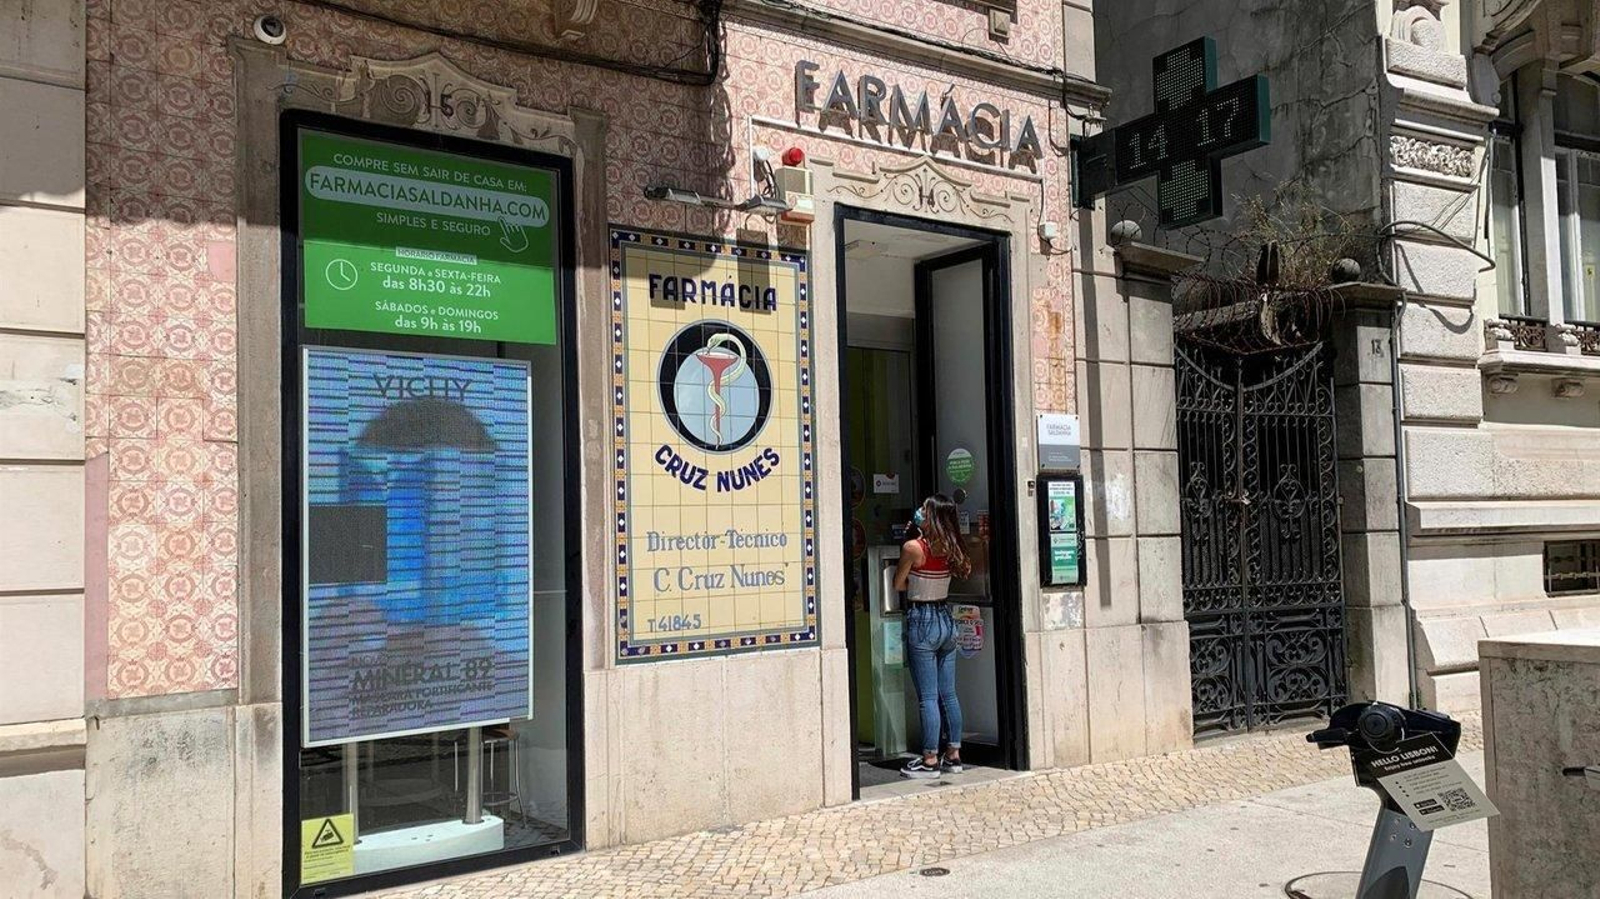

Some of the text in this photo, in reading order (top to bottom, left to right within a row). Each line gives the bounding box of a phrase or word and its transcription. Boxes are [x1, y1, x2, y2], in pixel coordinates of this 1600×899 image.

[795, 59, 1043, 159] FARMÁCIA
[1129, 97, 1239, 169] 14 17
[333, 153, 527, 192] COMPRE SEM SAIR DE CASA EM:
[310, 173, 546, 221] FARMACIASALDANHA.COM
[376, 212, 491, 236] SIMPLES E SEGURO
[370, 261, 426, 277] SEGUNDA
[435, 268, 501, 284] SEXTA-FEIRA
[383, 276, 491, 297] das 8h30 às 22h
[649, 273, 777, 311] FARMÁCIA
[375, 299, 429, 315] SÁBADOS
[438, 306, 499, 320] DOMINGOS
[395, 315, 481, 333] das 9h às 19h
[373, 373, 472, 401] VICHY
[655, 444, 780, 492] CRUZ NUNES
[653, 566, 672, 592] C.
[678, 565, 725, 592] Cruz
[465, 658, 493, 681] 89
[1370, 745, 1438, 767] HELLO LISBON!
